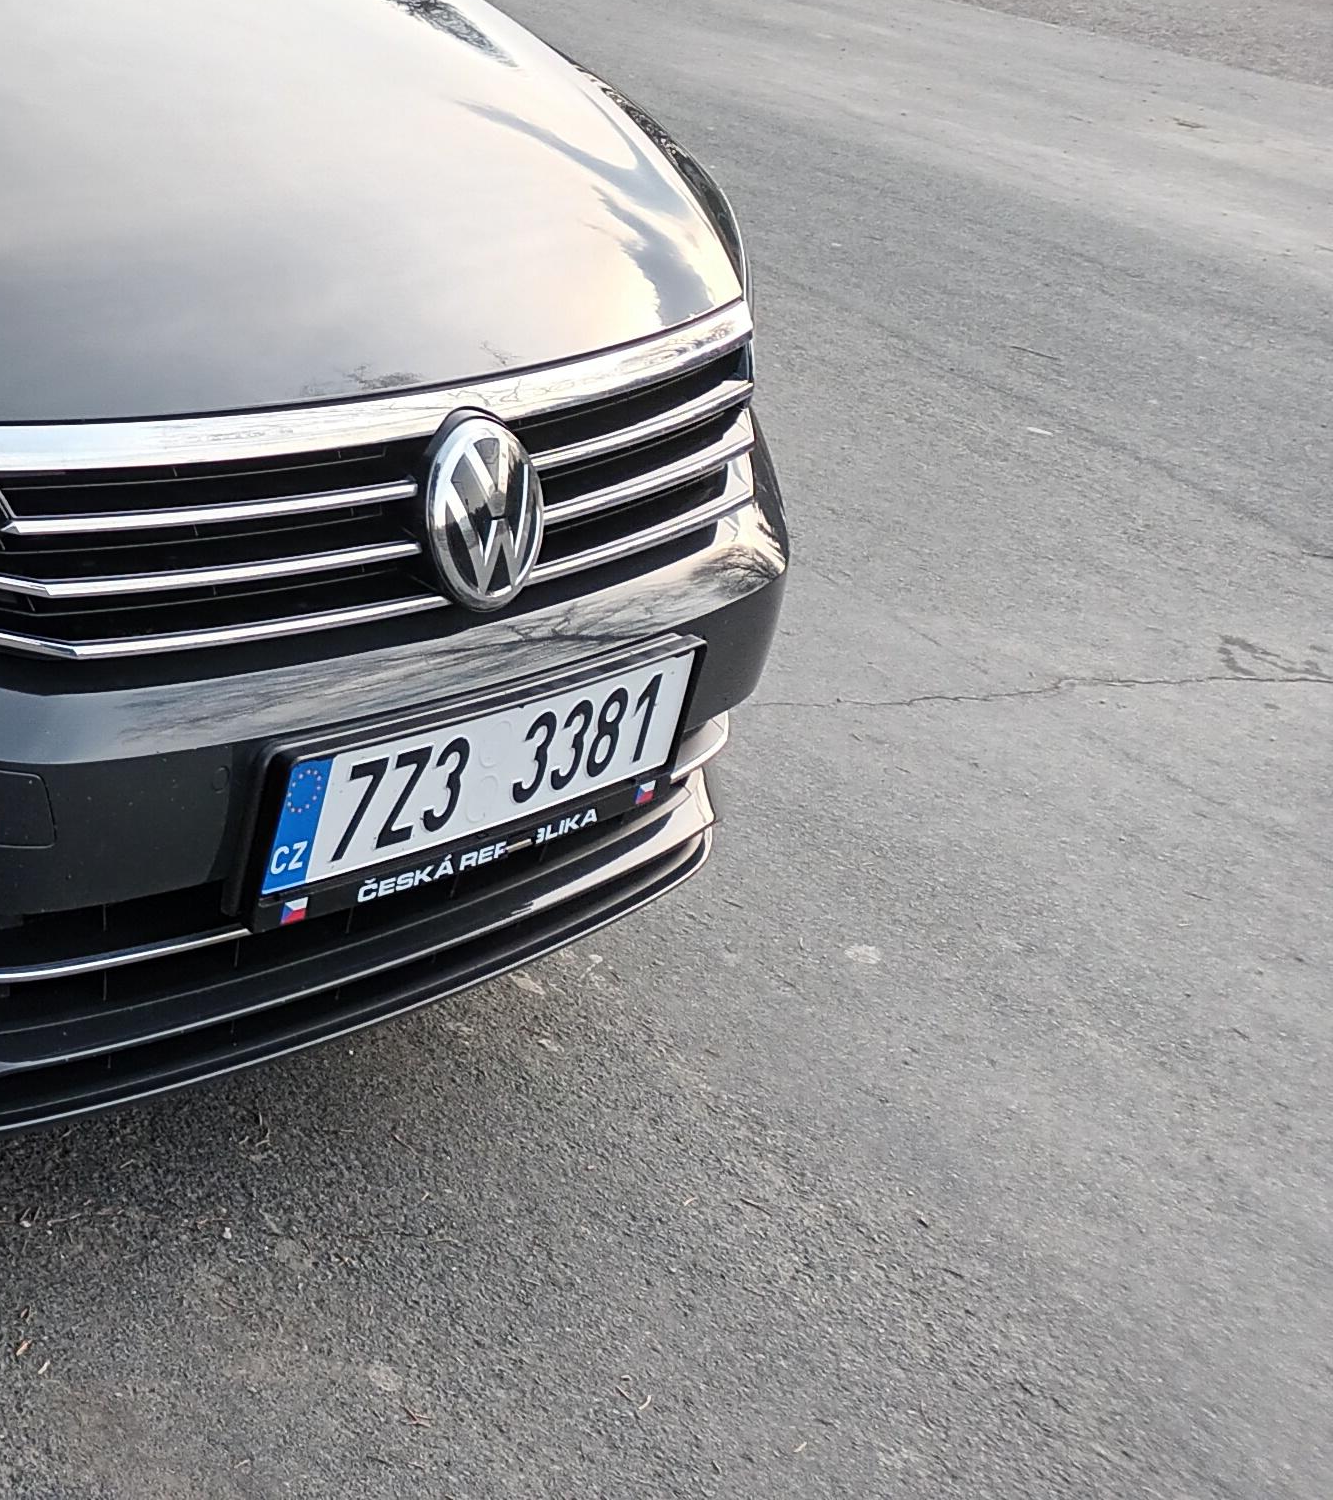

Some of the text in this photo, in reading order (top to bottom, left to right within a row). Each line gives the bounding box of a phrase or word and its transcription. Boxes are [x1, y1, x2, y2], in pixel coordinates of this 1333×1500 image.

[330, 672, 664, 863] 7Z3 3381
[270, 841, 307, 876] CZ
[357, 854, 455, 904] ČESKÁ
